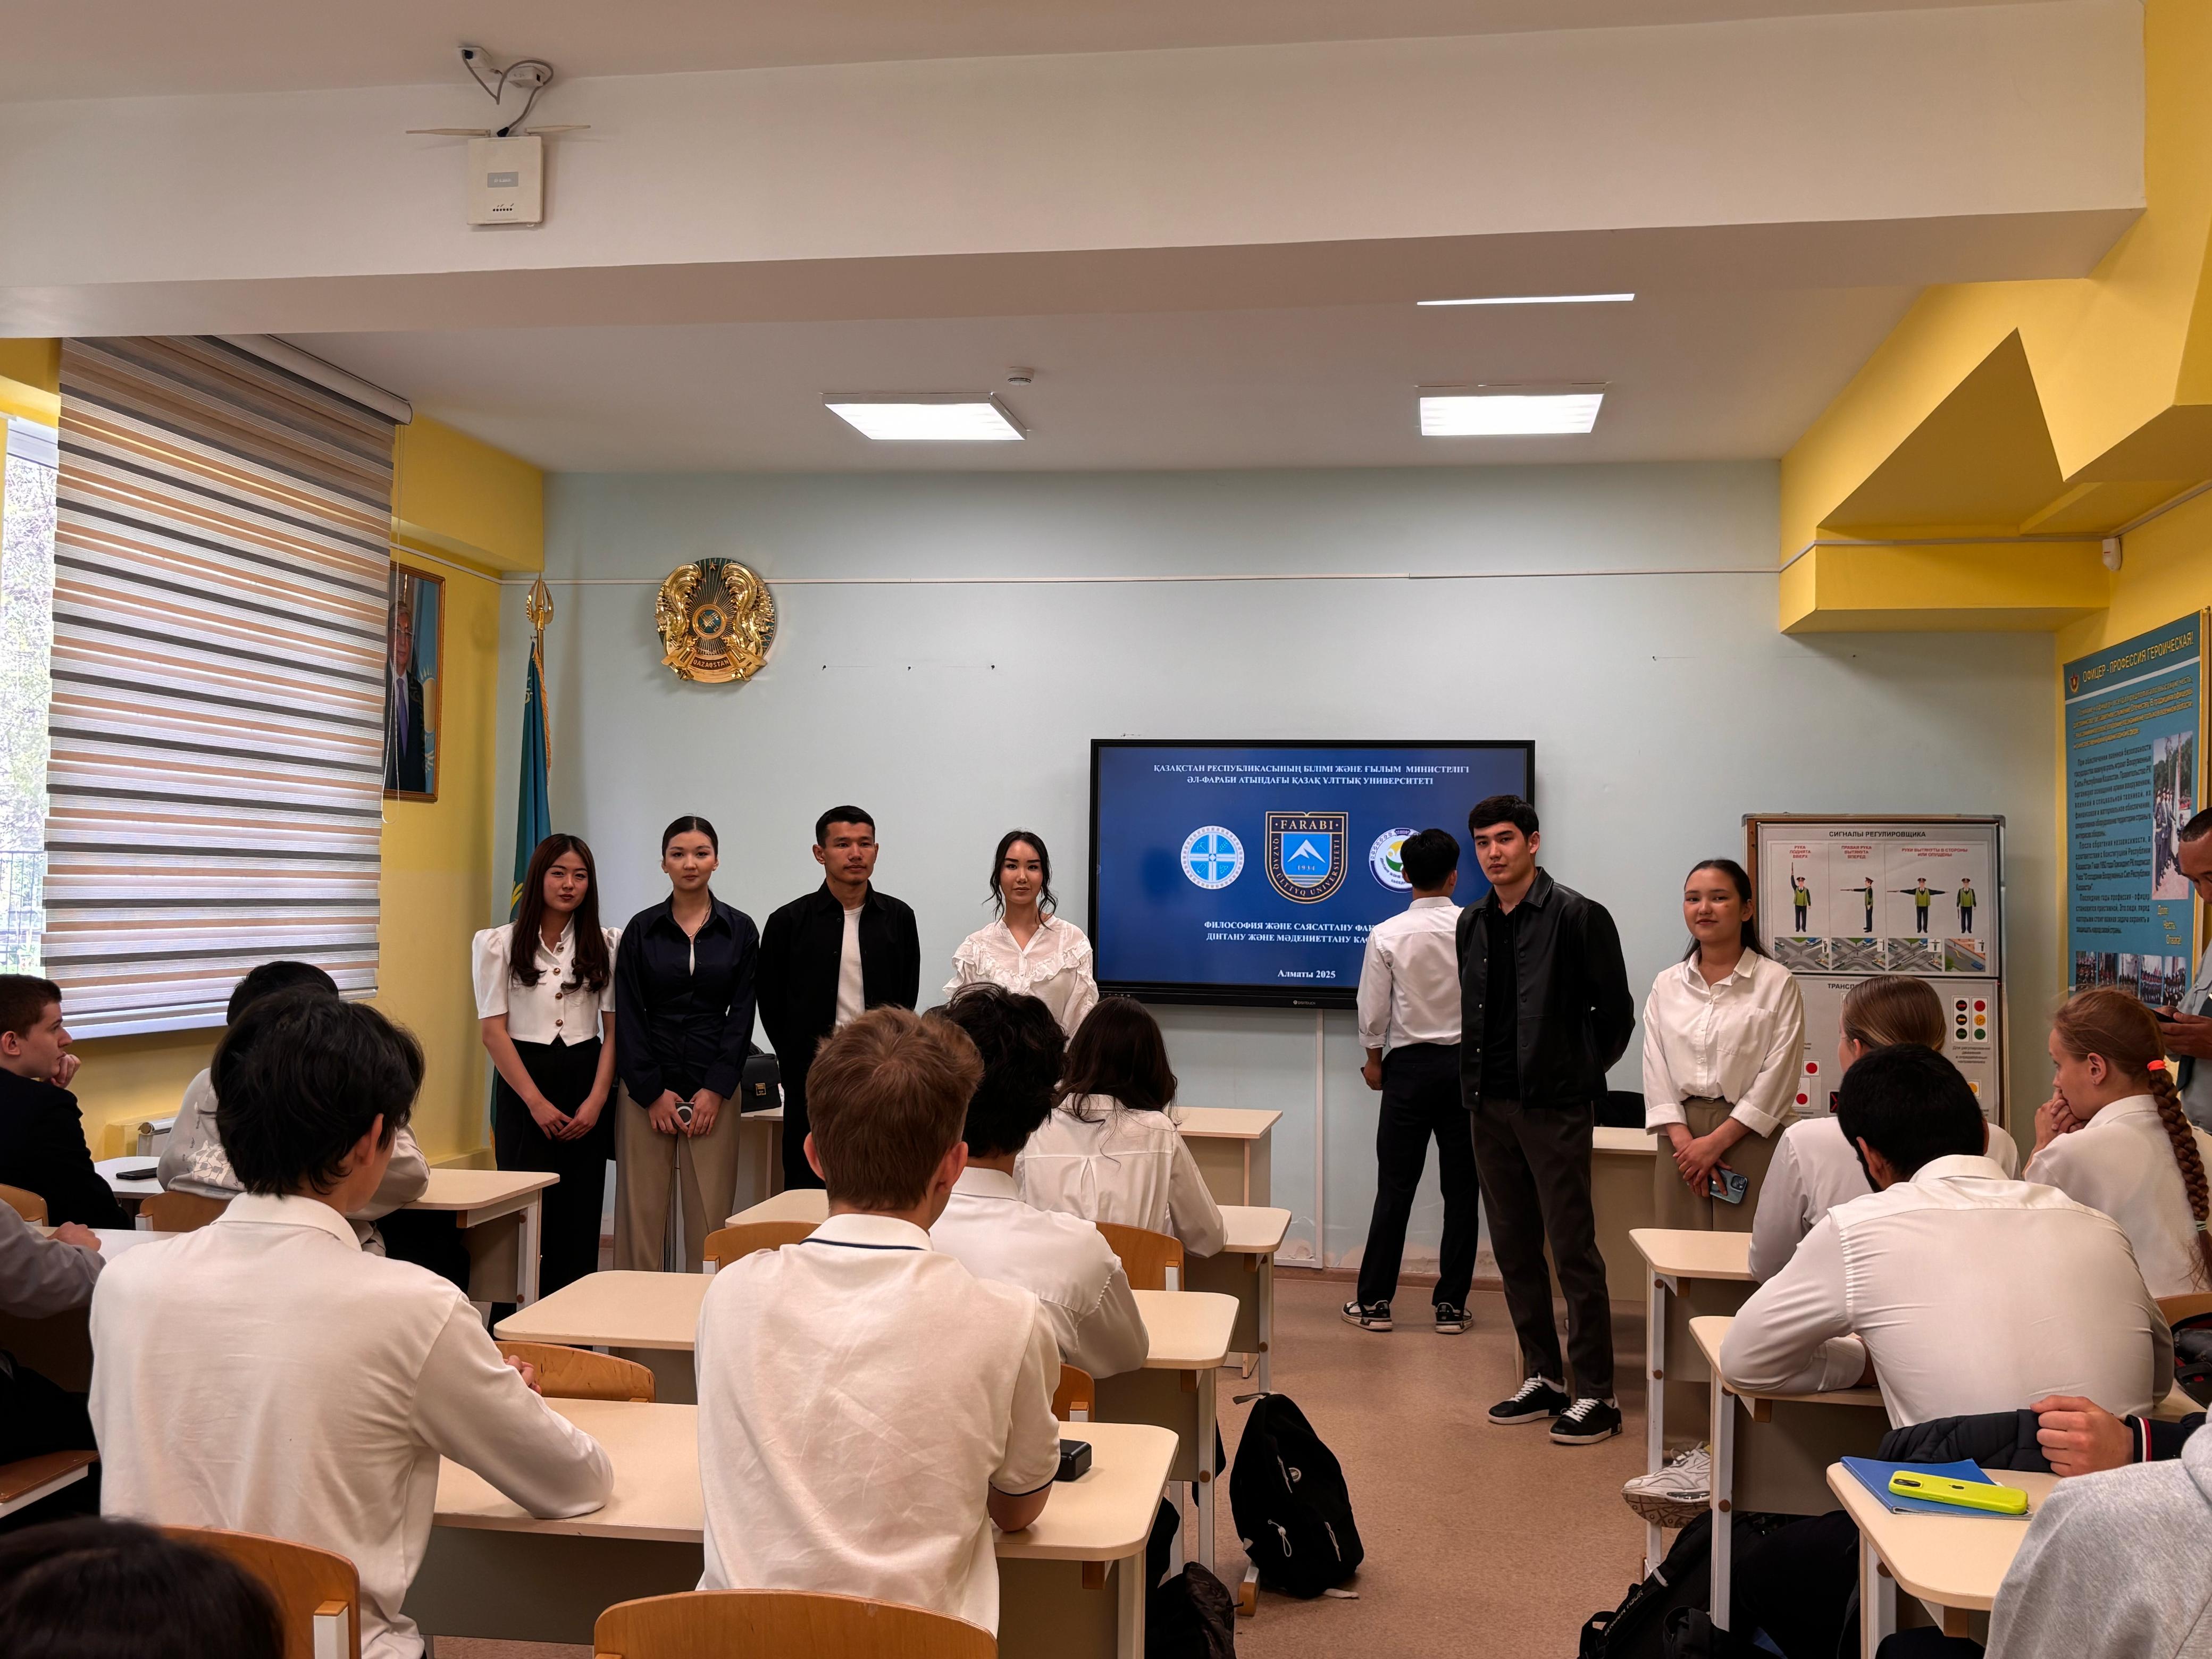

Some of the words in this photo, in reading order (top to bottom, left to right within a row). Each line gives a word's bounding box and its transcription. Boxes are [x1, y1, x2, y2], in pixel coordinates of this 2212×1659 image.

[693, 659, 729, 668] QAZAQSTAN
[2083, 664, 2106, 683] ОФИЦЕР
[2109, 649, 2146, 673] ПРОФЕССИЯ
[1208, 765, 1301, 774] РЕСПУБЛИКАСЫНЫҢ
[1280, 820, 1333, 830] FARABI
[1204, 921, 1263, 929] ФИЛОСОФИЯ
[1293, 923, 1353, 931] САЯСАТТАНУ
[1276, 934, 1351, 943] МӘДЕНИЕТТАНУ
[1278, 969, 1313, 978] Алматы
[1316, 970, 1336, 979] 2025
